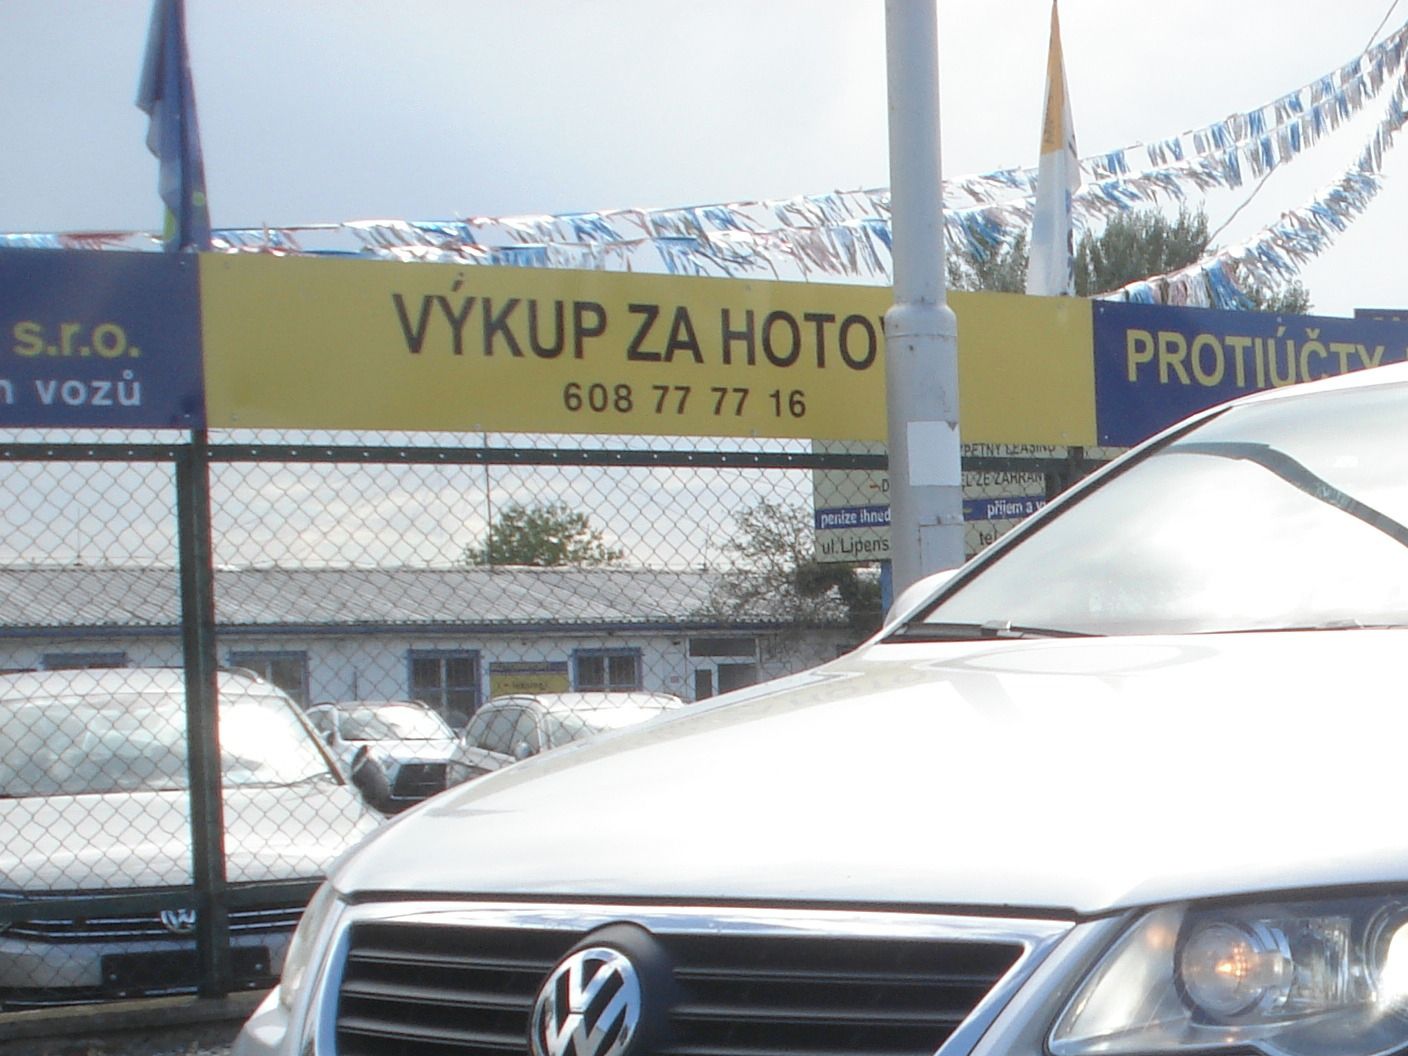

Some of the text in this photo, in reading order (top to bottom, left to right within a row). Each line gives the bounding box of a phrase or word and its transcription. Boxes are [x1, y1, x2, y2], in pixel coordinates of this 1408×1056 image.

[13, 320, 141, 359] s.r.o.
[393, 272, 887, 371] VÝKUP ZA HOTO
[35, 369, 141, 406] vozů
[563, 382, 807, 418] 608 77 77 16
[841, 538, 889, 556] Lipens
